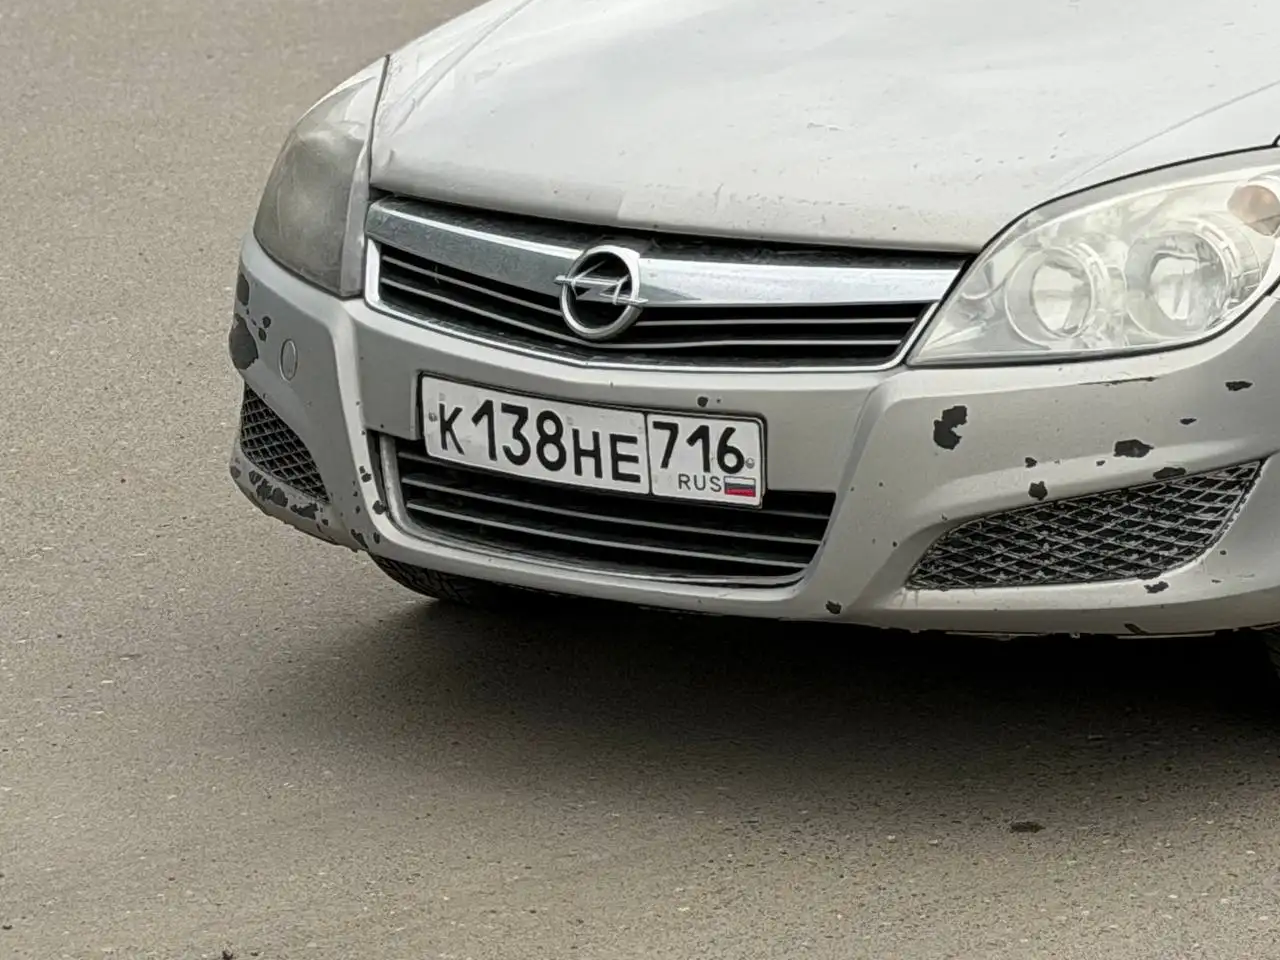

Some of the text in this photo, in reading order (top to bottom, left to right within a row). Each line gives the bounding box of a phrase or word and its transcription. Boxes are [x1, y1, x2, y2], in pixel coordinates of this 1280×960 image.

[438, 399, 745, 484] К138НЕ 716
[677, 473, 722, 493] RUS
